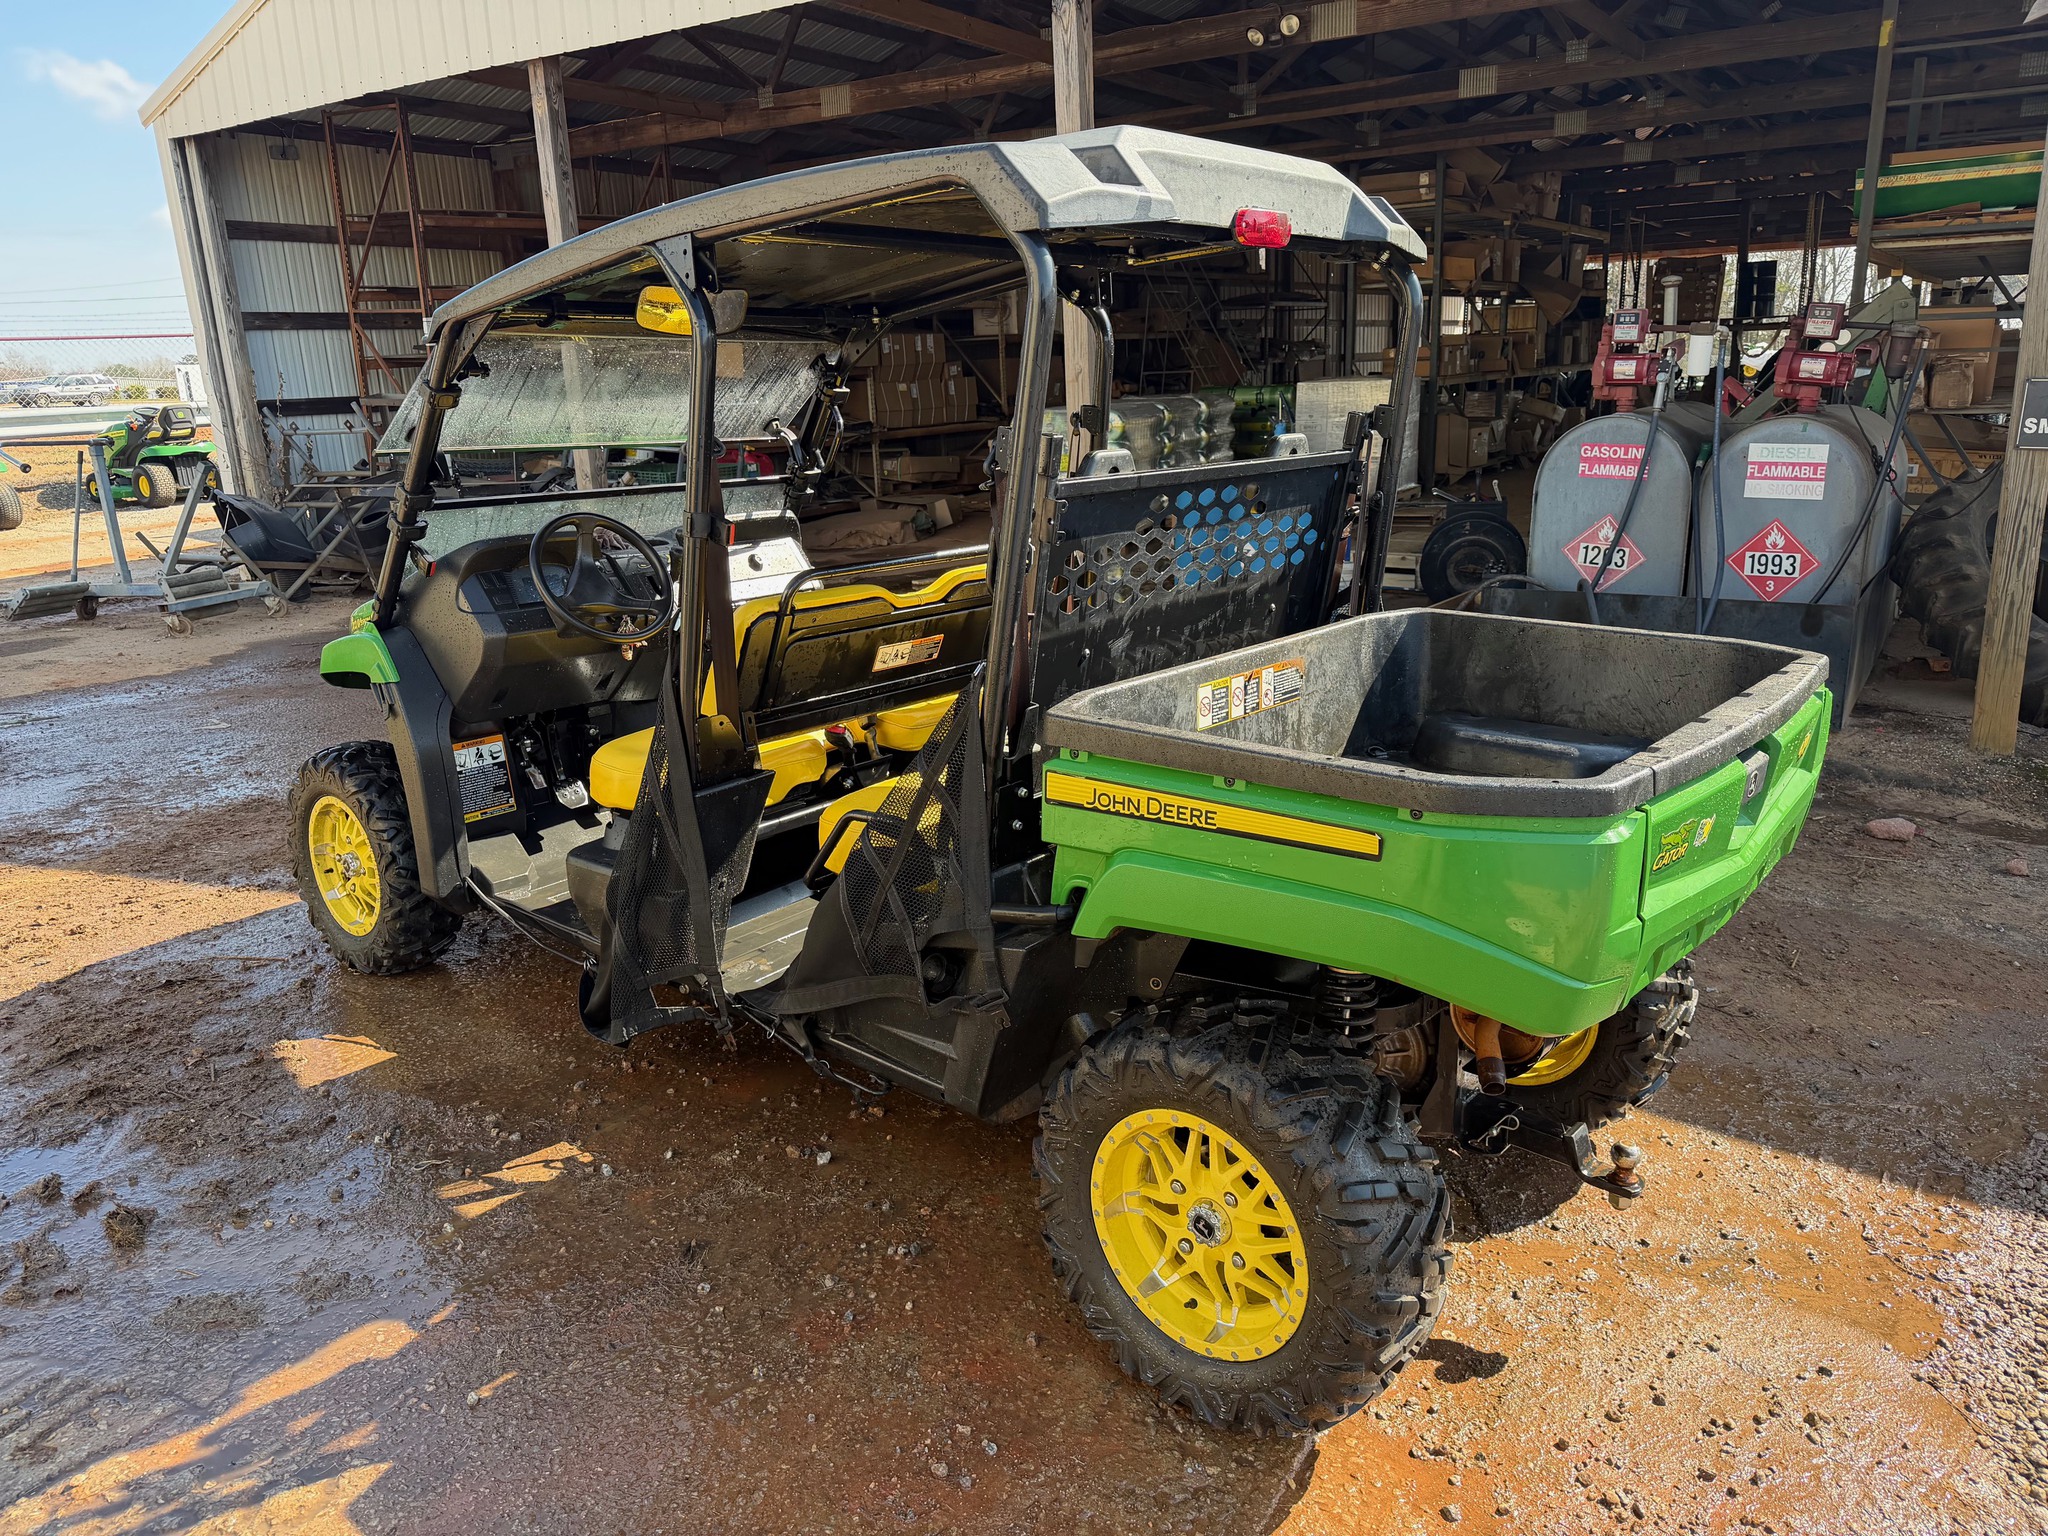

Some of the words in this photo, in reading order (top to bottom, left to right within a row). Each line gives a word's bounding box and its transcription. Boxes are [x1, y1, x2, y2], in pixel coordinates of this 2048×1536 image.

[1760, 447, 1816, 459] DIESEL
[1747, 465, 1826, 478] FLAMMABLE
[1747, 483, 1762, 496] NO
[1767, 483, 1823, 497] SMOKING
[1748, 553, 1797, 576] 1993
[1765, 580, 1775, 592] 3
[1086, 788, 1141, 813] JOHN
[1147, 797, 1217, 826] DEERE
[1653, 842, 1688, 872] GATOR
